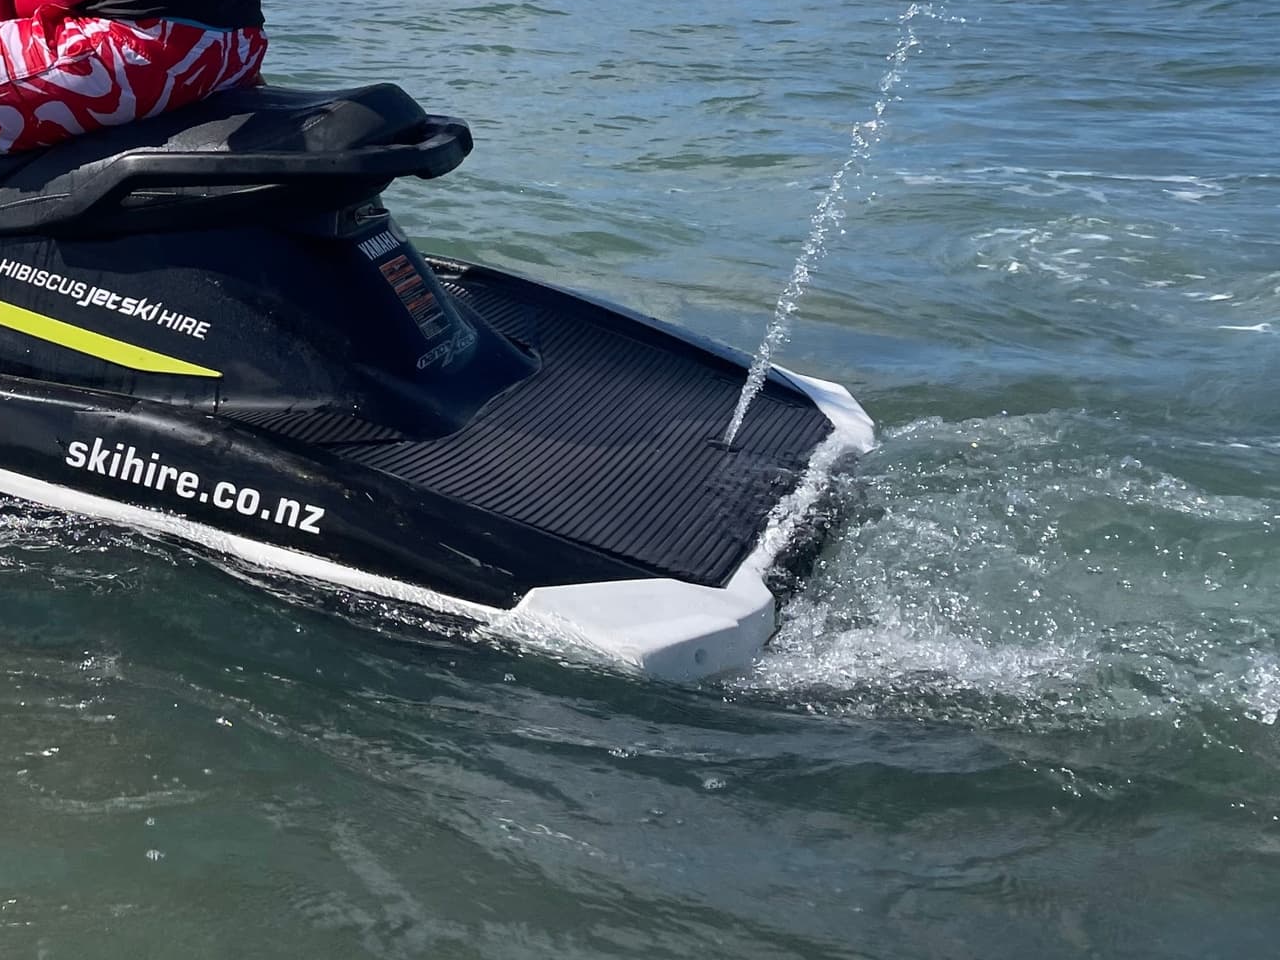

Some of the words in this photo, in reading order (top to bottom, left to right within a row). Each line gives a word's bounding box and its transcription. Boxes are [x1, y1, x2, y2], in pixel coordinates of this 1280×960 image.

[358, 231, 400, 261] YAMAHA
[156, 308, 211, 340] HIRE
[65, 437, 326, 535] skihire.co.nz
